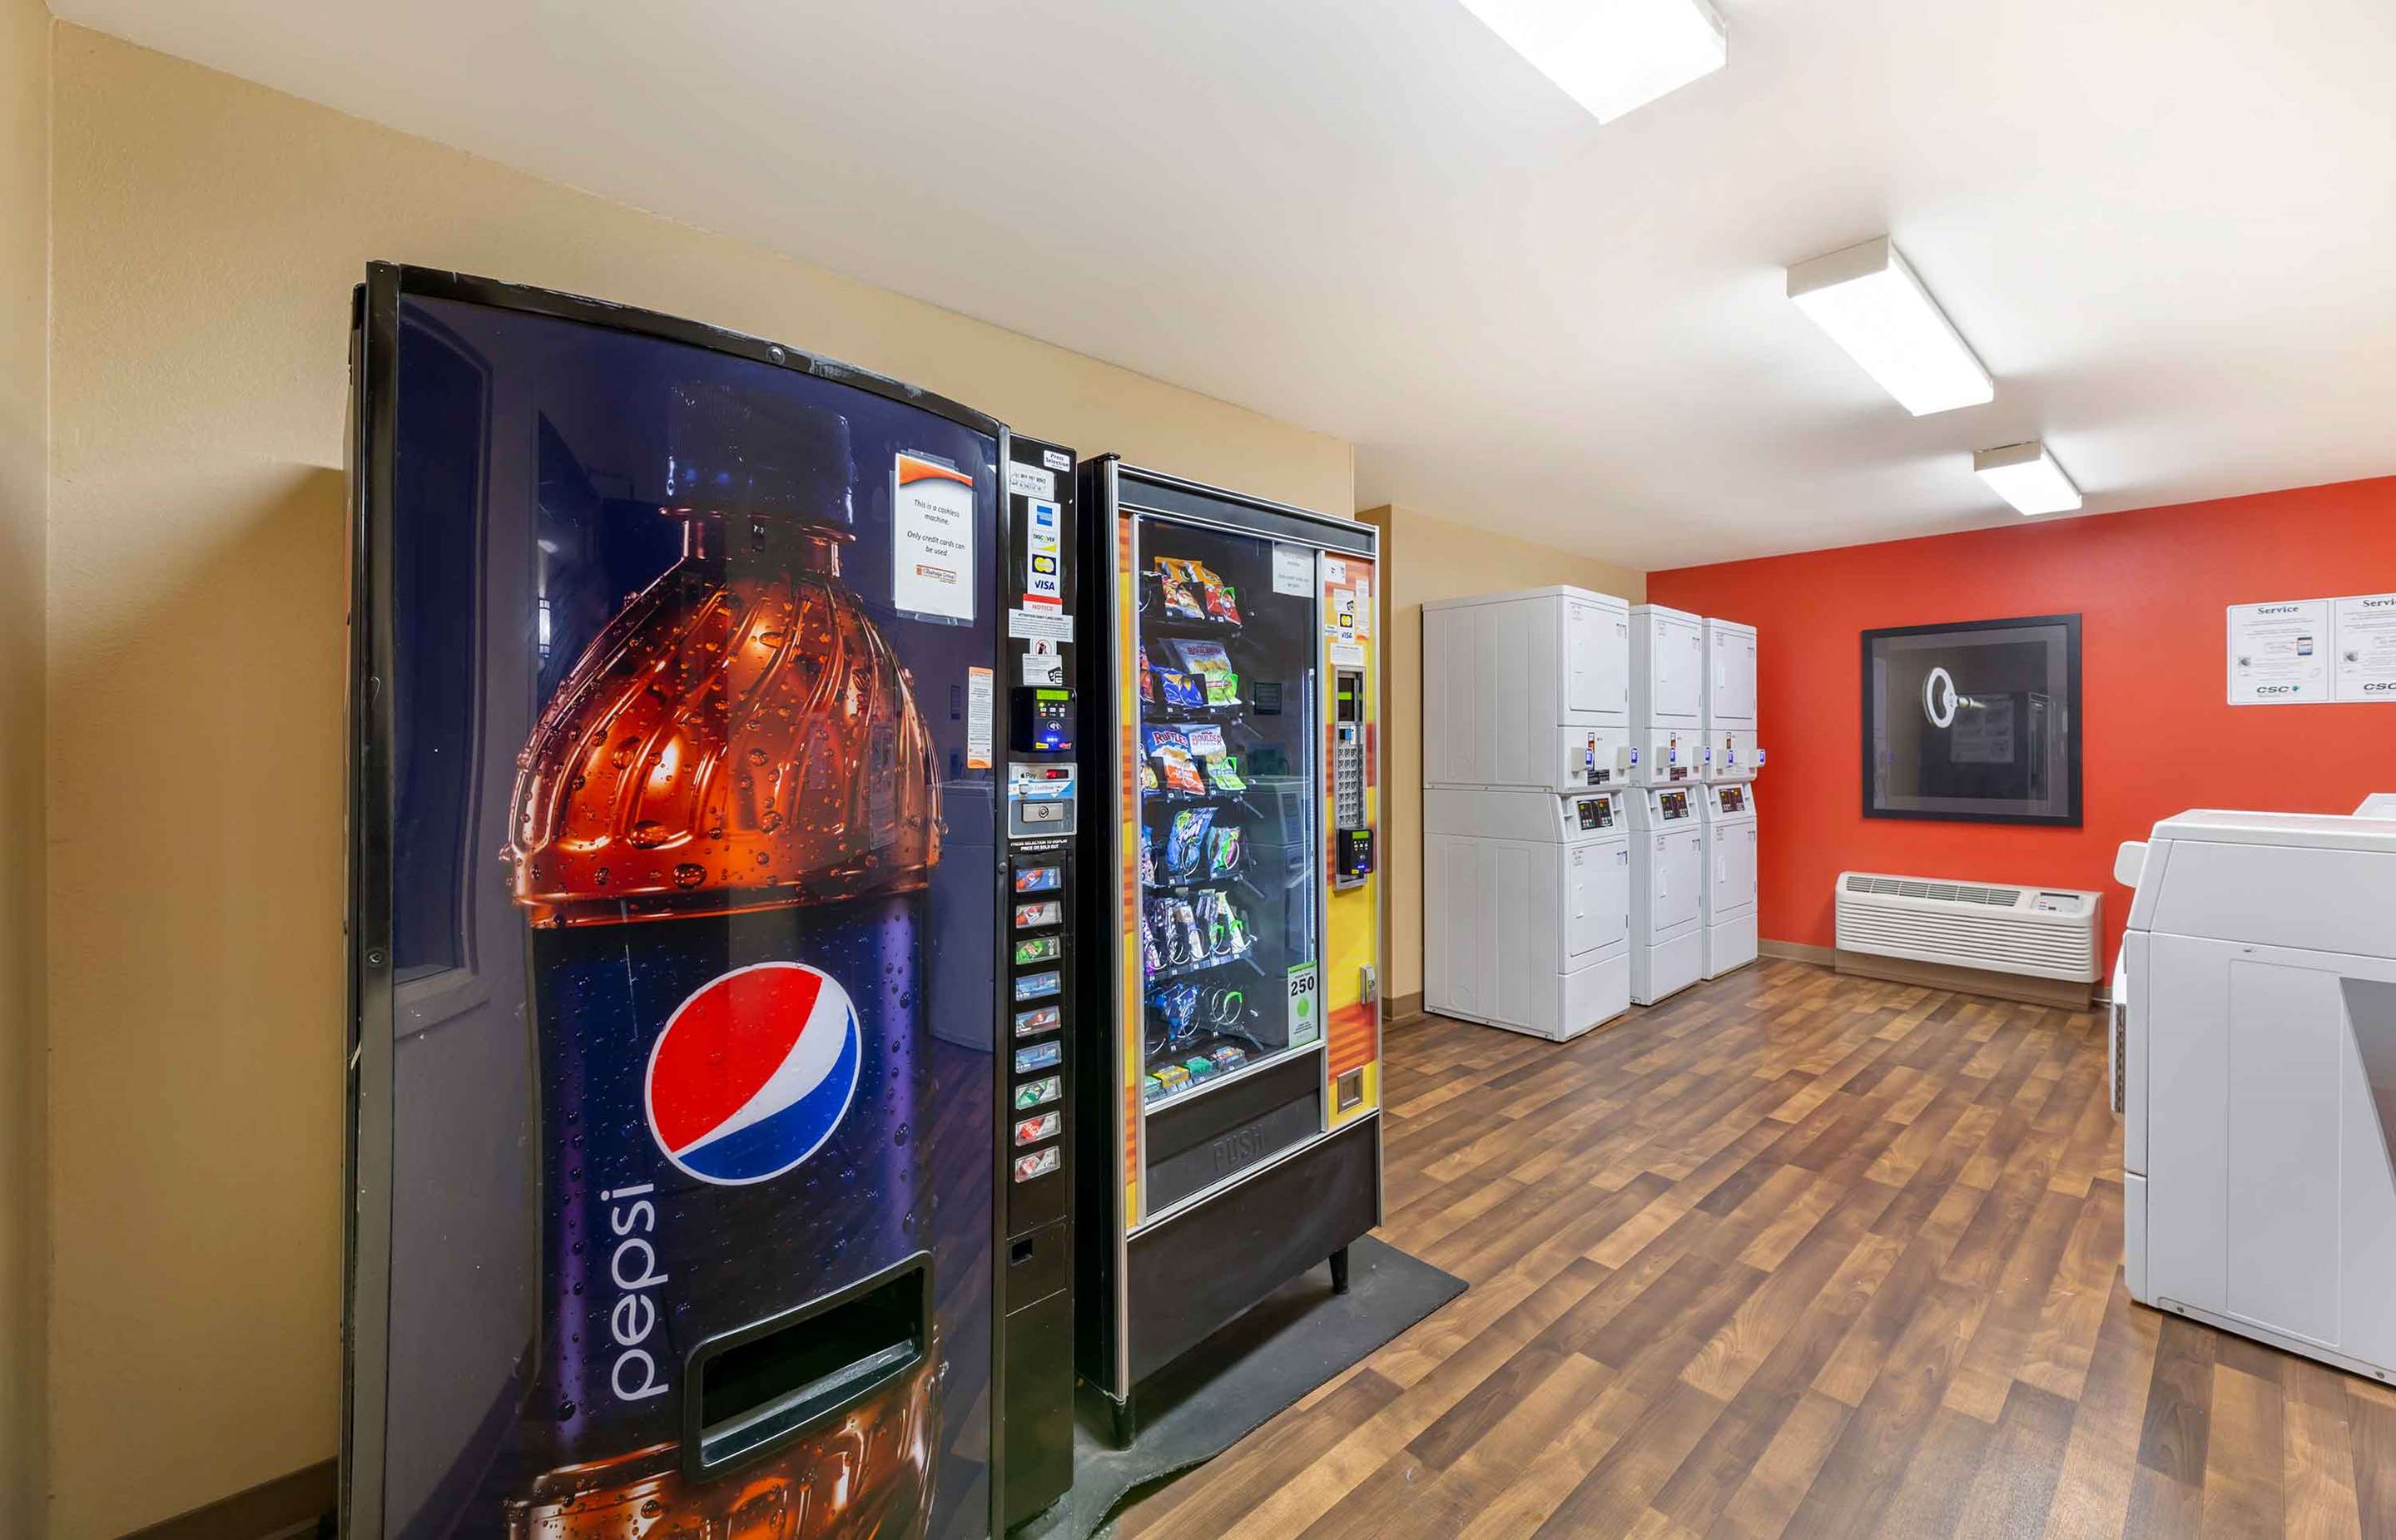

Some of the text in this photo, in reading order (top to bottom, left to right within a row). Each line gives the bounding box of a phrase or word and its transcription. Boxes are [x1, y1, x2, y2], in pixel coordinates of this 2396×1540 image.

[914, 499, 925, 508] This
[938, 507, 960, 517] cashless
[907, 531, 921, 541] Only
[922, 535, 939, 543] credit
[940, 539, 955, 547] cards
[1034, 580, 1055, 591] VISA
[2363, 598, 2396, 607] Servi
[2257, 607, 2299, 615] Service
[2256, 686, 2289, 694] CSC
[2364, 682, 2396, 691] CSC
[1153, 731, 1189, 748] RUFFLES
[1025, 771, 1037, 780] Pay
[1291, 975, 1315, 997] 250
[1213, 1122, 1265, 1172] PUSH
[600, 1183, 669, 1401] pepsi
